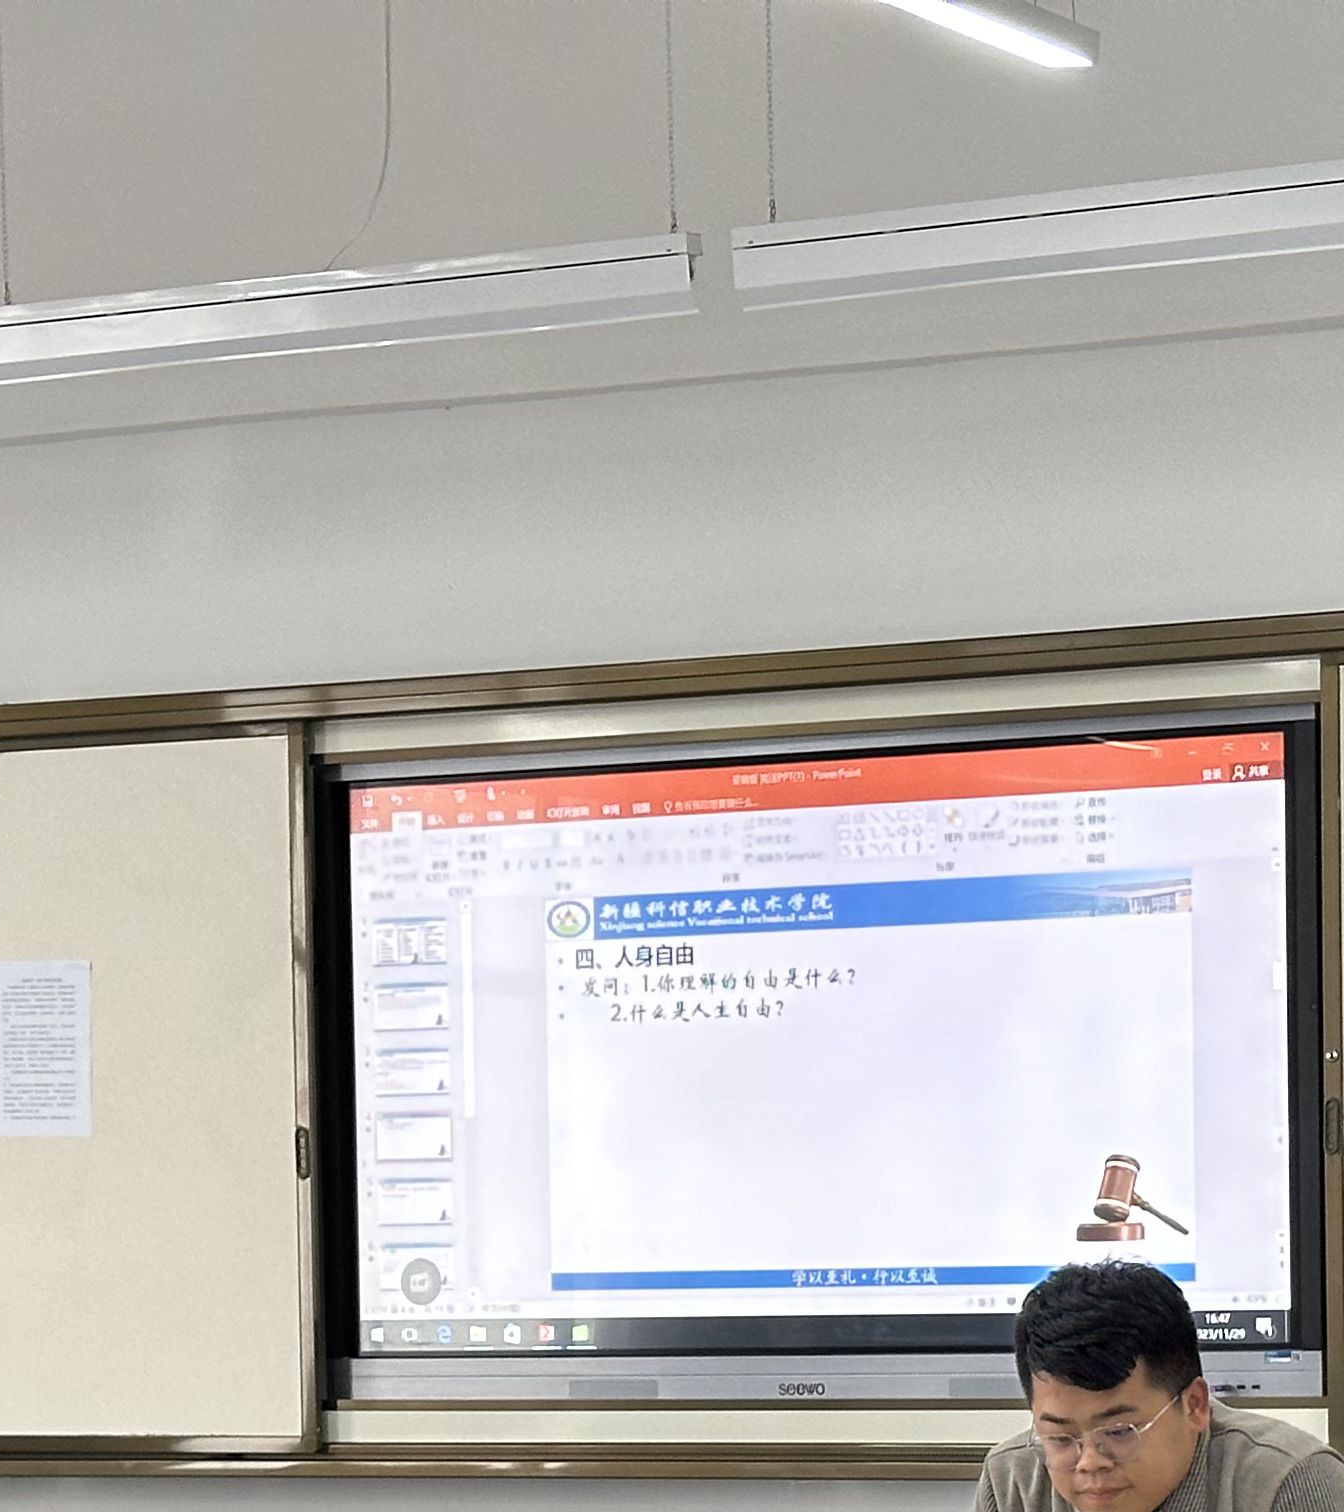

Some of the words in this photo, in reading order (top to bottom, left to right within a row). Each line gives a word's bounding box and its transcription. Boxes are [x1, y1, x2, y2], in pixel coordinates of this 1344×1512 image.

[599, 892, 833, 920] 新疆科信职业技术学院
[575, 942, 695, 971] 四、人身自由
[1196, 1327, 1246, 1341] 023/11/29
[778, 1382, 826, 1397] seewo
